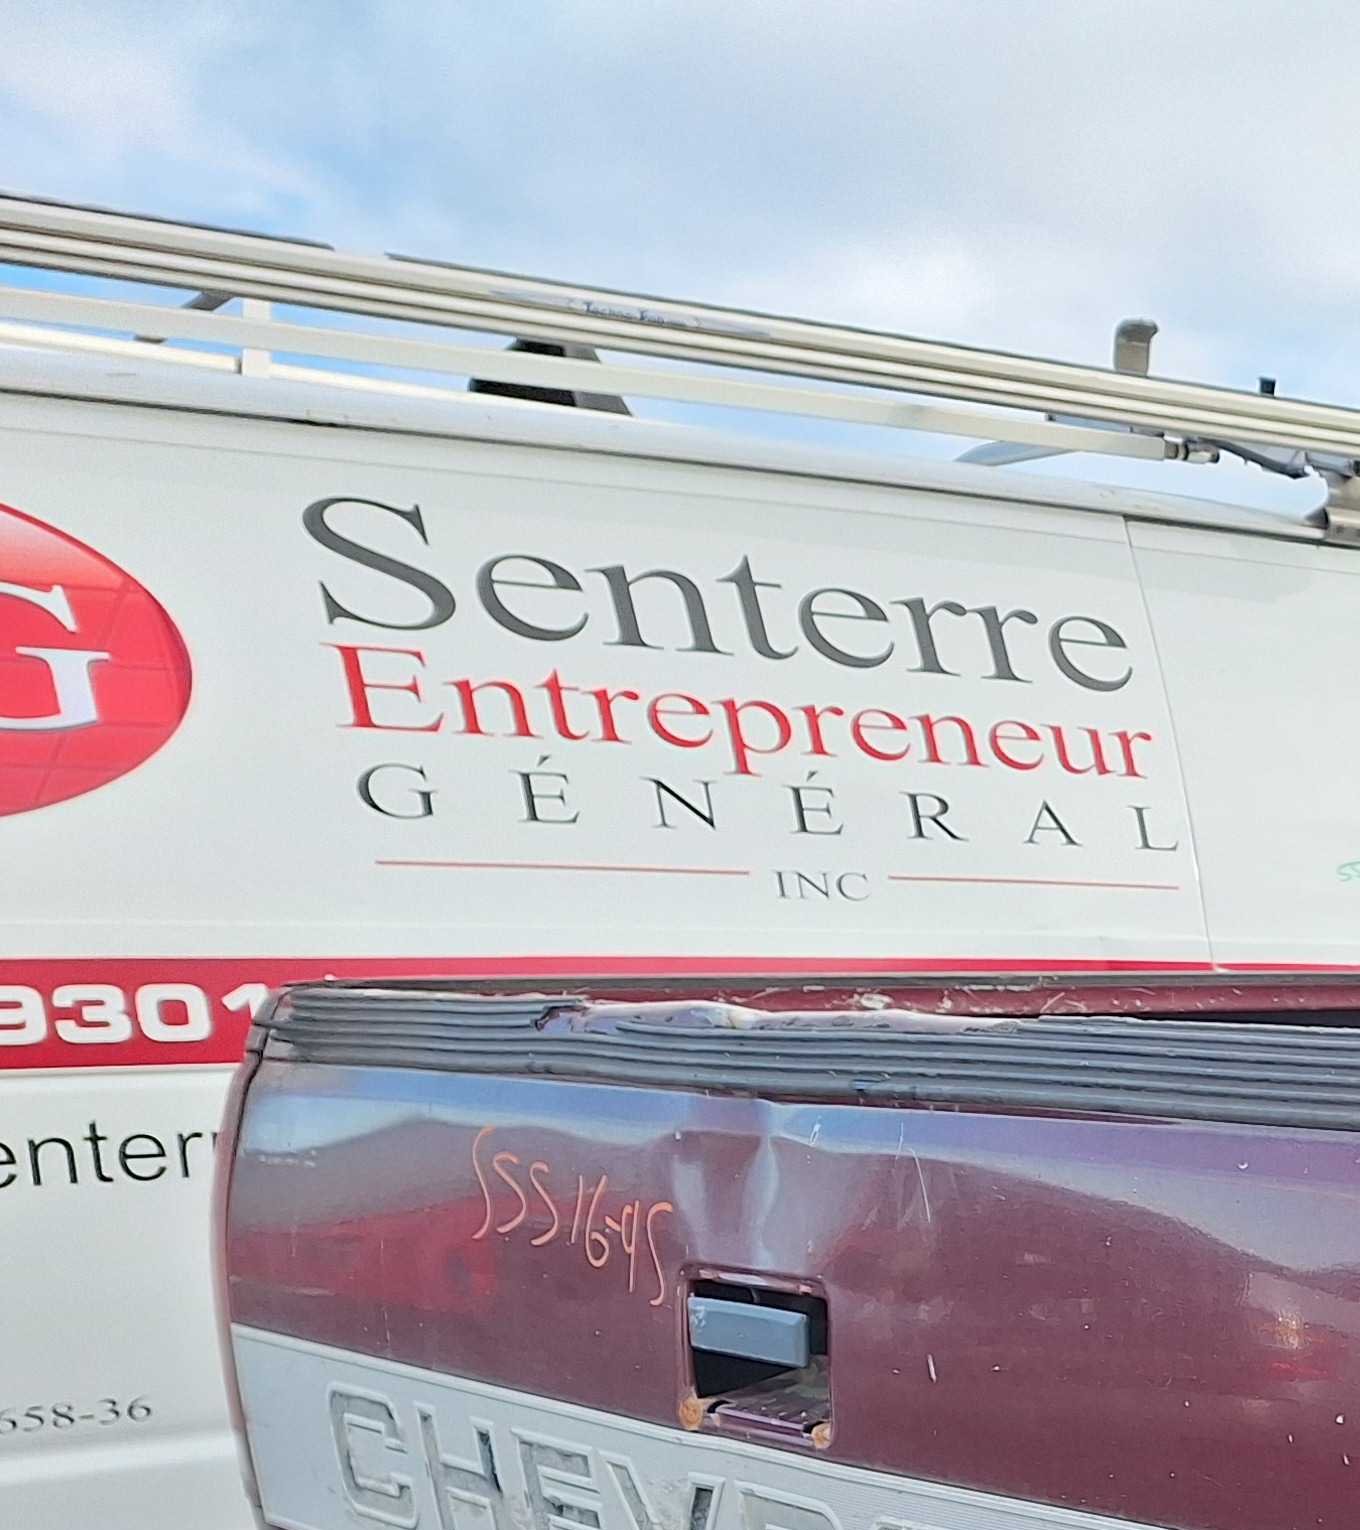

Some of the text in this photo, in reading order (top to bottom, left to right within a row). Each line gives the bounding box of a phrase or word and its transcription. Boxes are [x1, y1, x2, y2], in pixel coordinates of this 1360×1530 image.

[302, 495, 1134, 693] Senterre
[319, 641, 1153, 779] Entrepreneur
[355, 753, 1179, 852] GÉNÉRAL
[771, 869, 870, 902] INC
[0, 1121, 218, 1189] nter
